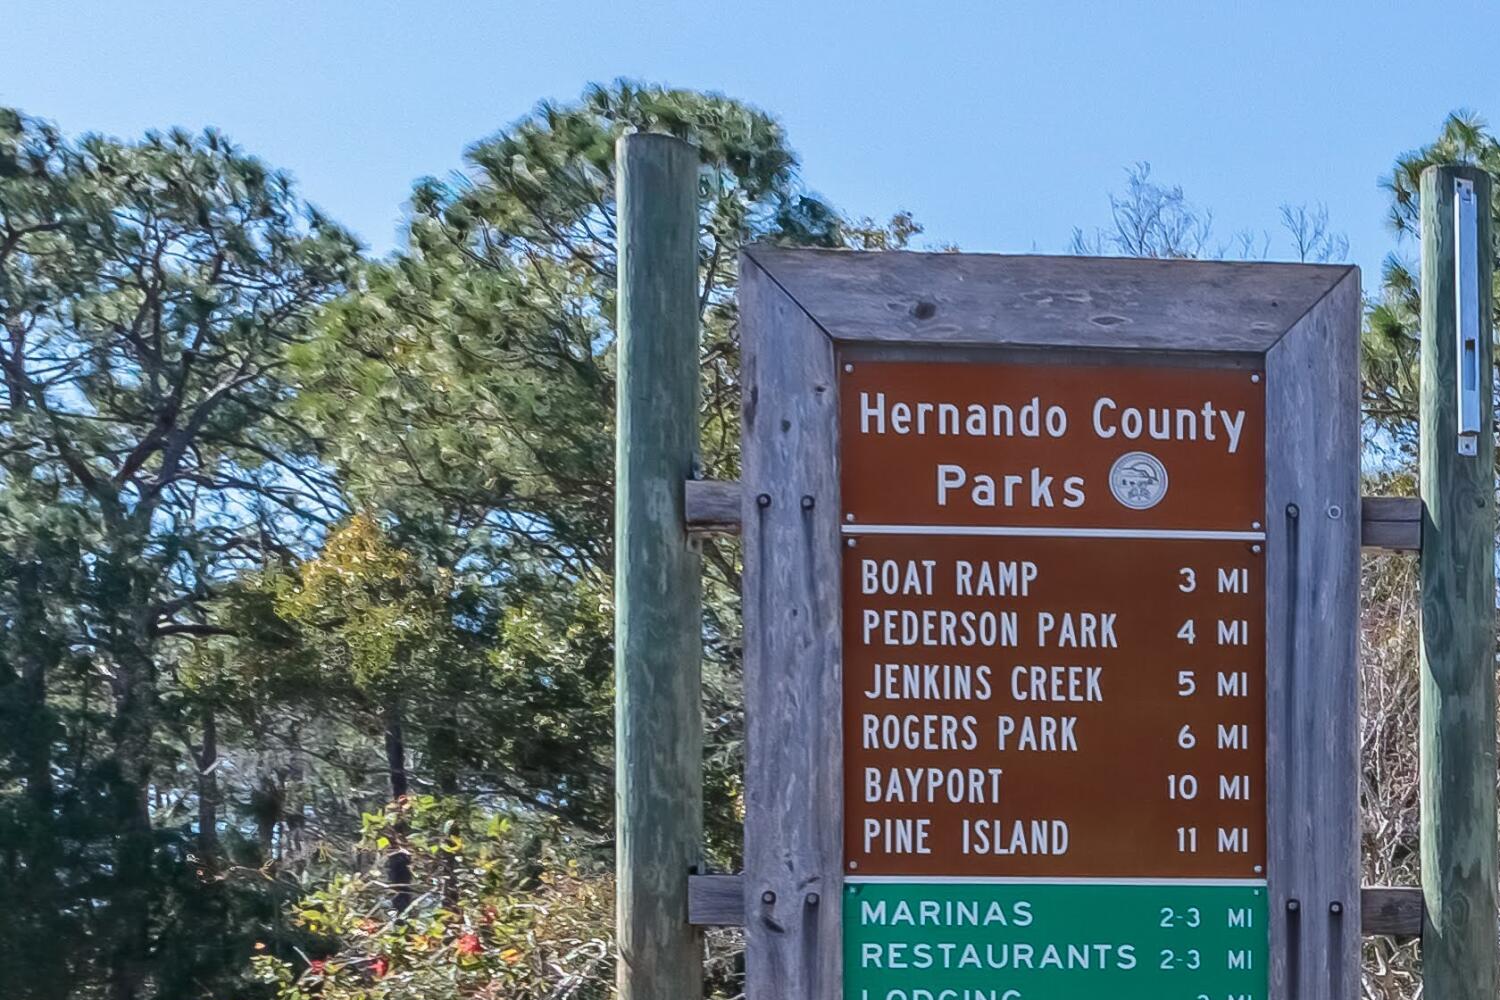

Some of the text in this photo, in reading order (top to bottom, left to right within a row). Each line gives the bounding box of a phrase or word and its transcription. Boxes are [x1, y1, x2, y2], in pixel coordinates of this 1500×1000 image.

[861, 393, 1245, 453] Hernando County
[938, 465, 1084, 507] Parks
[863, 560, 1247, 596] BOAT RAMP 3 MI
[864, 610, 1247, 647] PEDERSON PARK 4 MI
[865, 664, 1247, 701] JENKINS CREEK 5 MI
[864, 714, 1247, 751] ROGERS PARK 6 MI
[866, 768, 1248, 803] BAYPORT 10 MI
[865, 819, 1247, 854] PINE ISLAND 11 MI
[862, 901, 1251, 927] MARINAS 2-3 MI
[863, 944, 1251, 969] RESTAURANTS 2-3 MI
